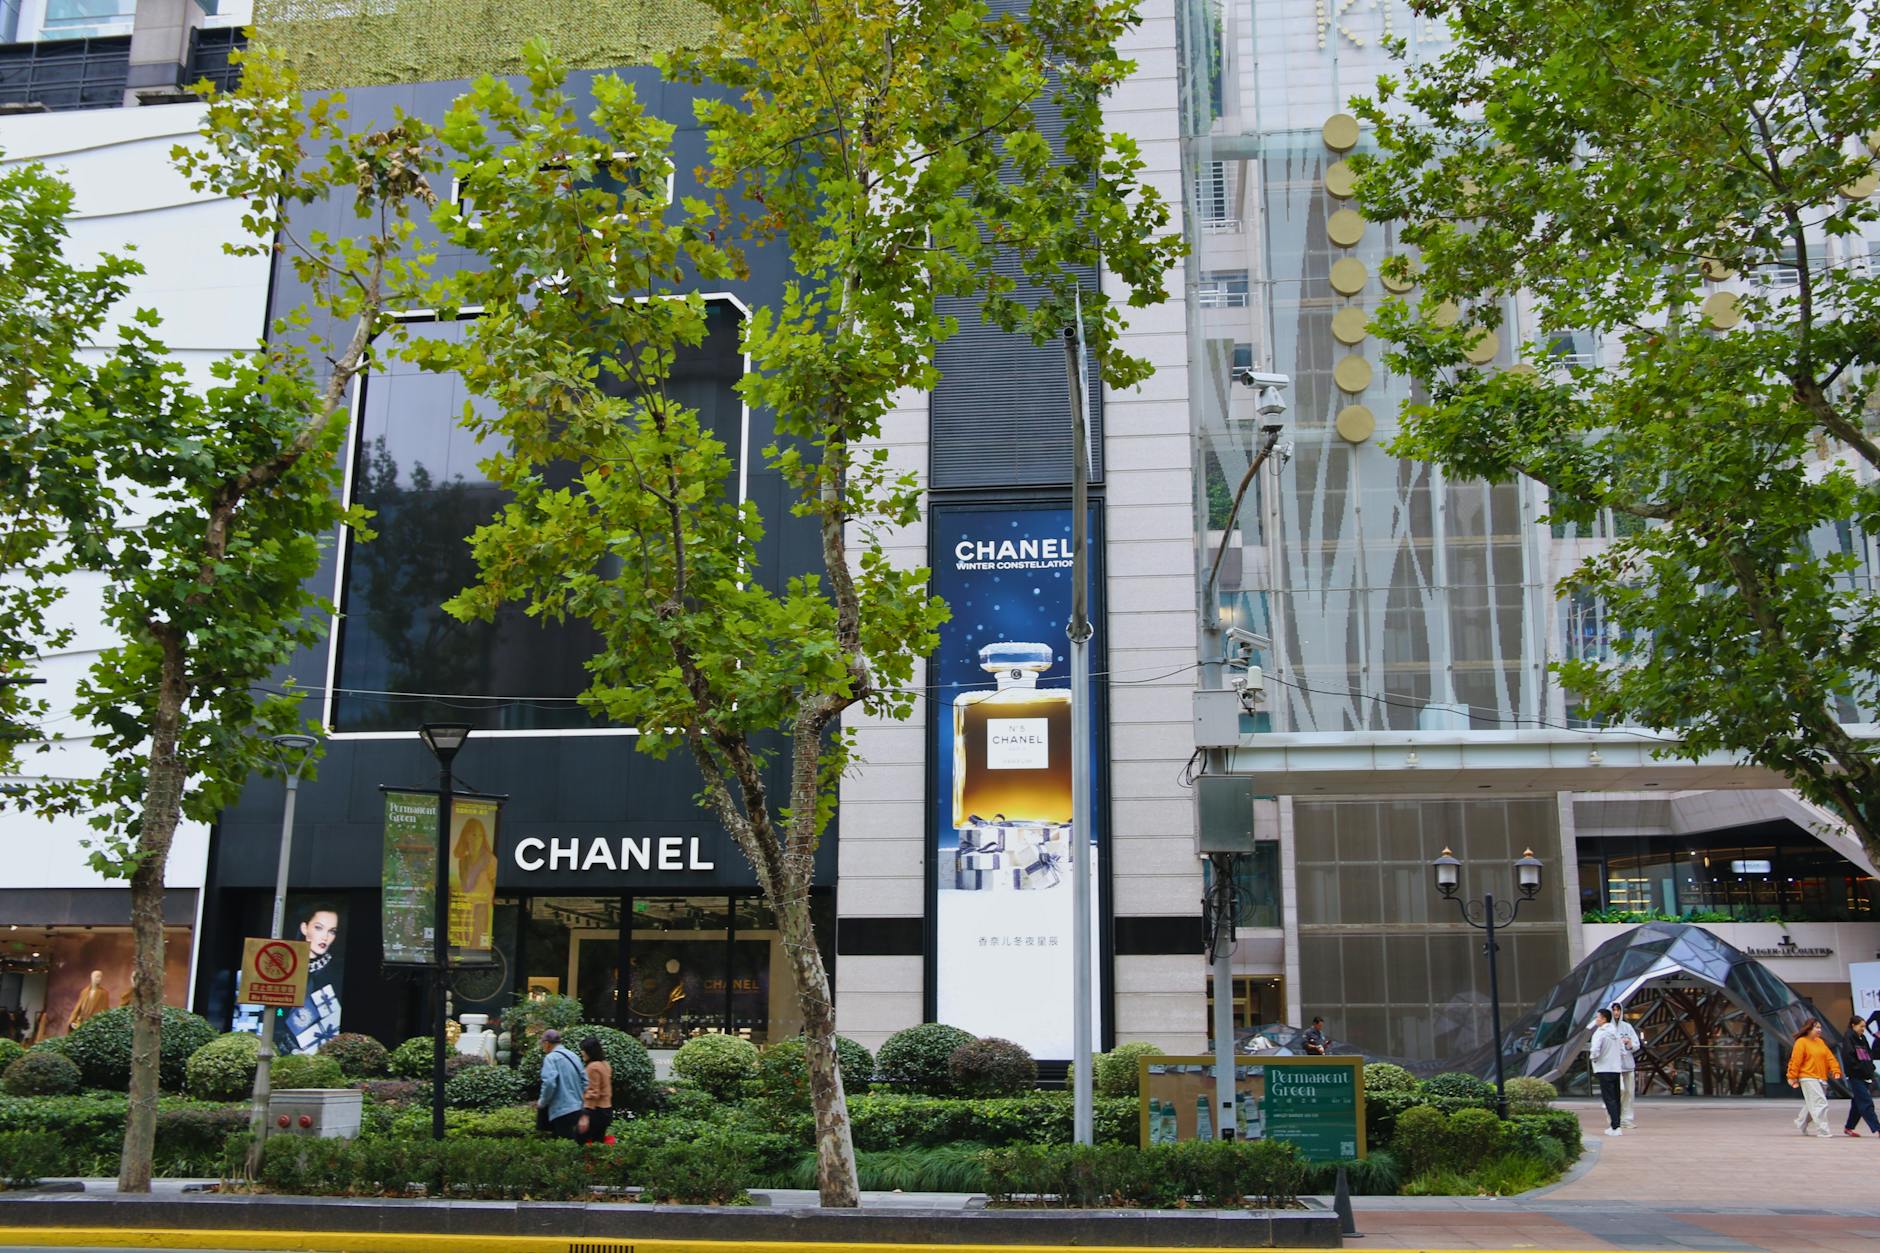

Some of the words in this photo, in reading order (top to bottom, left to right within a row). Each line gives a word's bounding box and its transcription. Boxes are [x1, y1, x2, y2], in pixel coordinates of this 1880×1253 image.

[955, 538, 1074, 561] CHANEL
[956, 561, 995, 570] WINTER
[992, 735, 1043, 744] CHANEL
[390, 802, 436, 816] Permanent
[389, 812, 417, 823] Green
[514, 837, 714, 871] CHANEL
[1272, 1069, 1350, 1084] Permanent
[1272, 1083, 1316, 1097] Green
